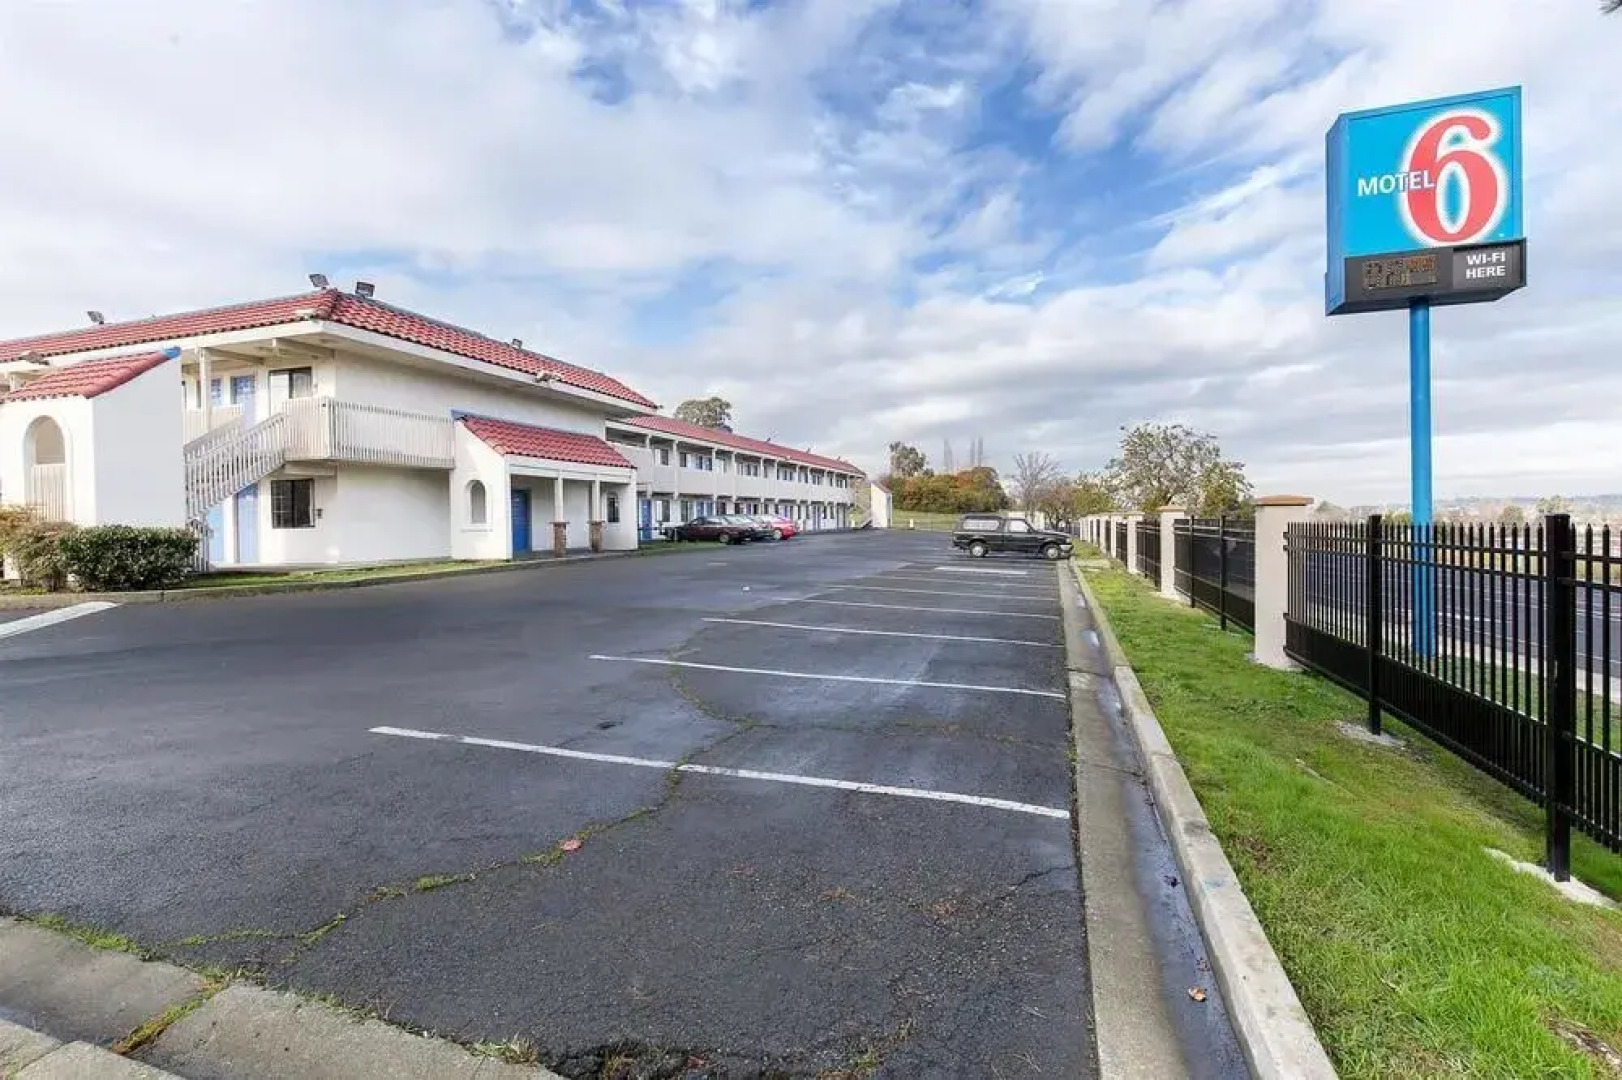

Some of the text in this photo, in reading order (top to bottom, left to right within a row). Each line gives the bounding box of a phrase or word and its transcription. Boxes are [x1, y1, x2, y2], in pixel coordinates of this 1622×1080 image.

[1357, 114, 1500, 244] MOTEL 6
[1466, 251, 1506, 265] WI-FI
[1465, 265, 1506, 280] HERE
